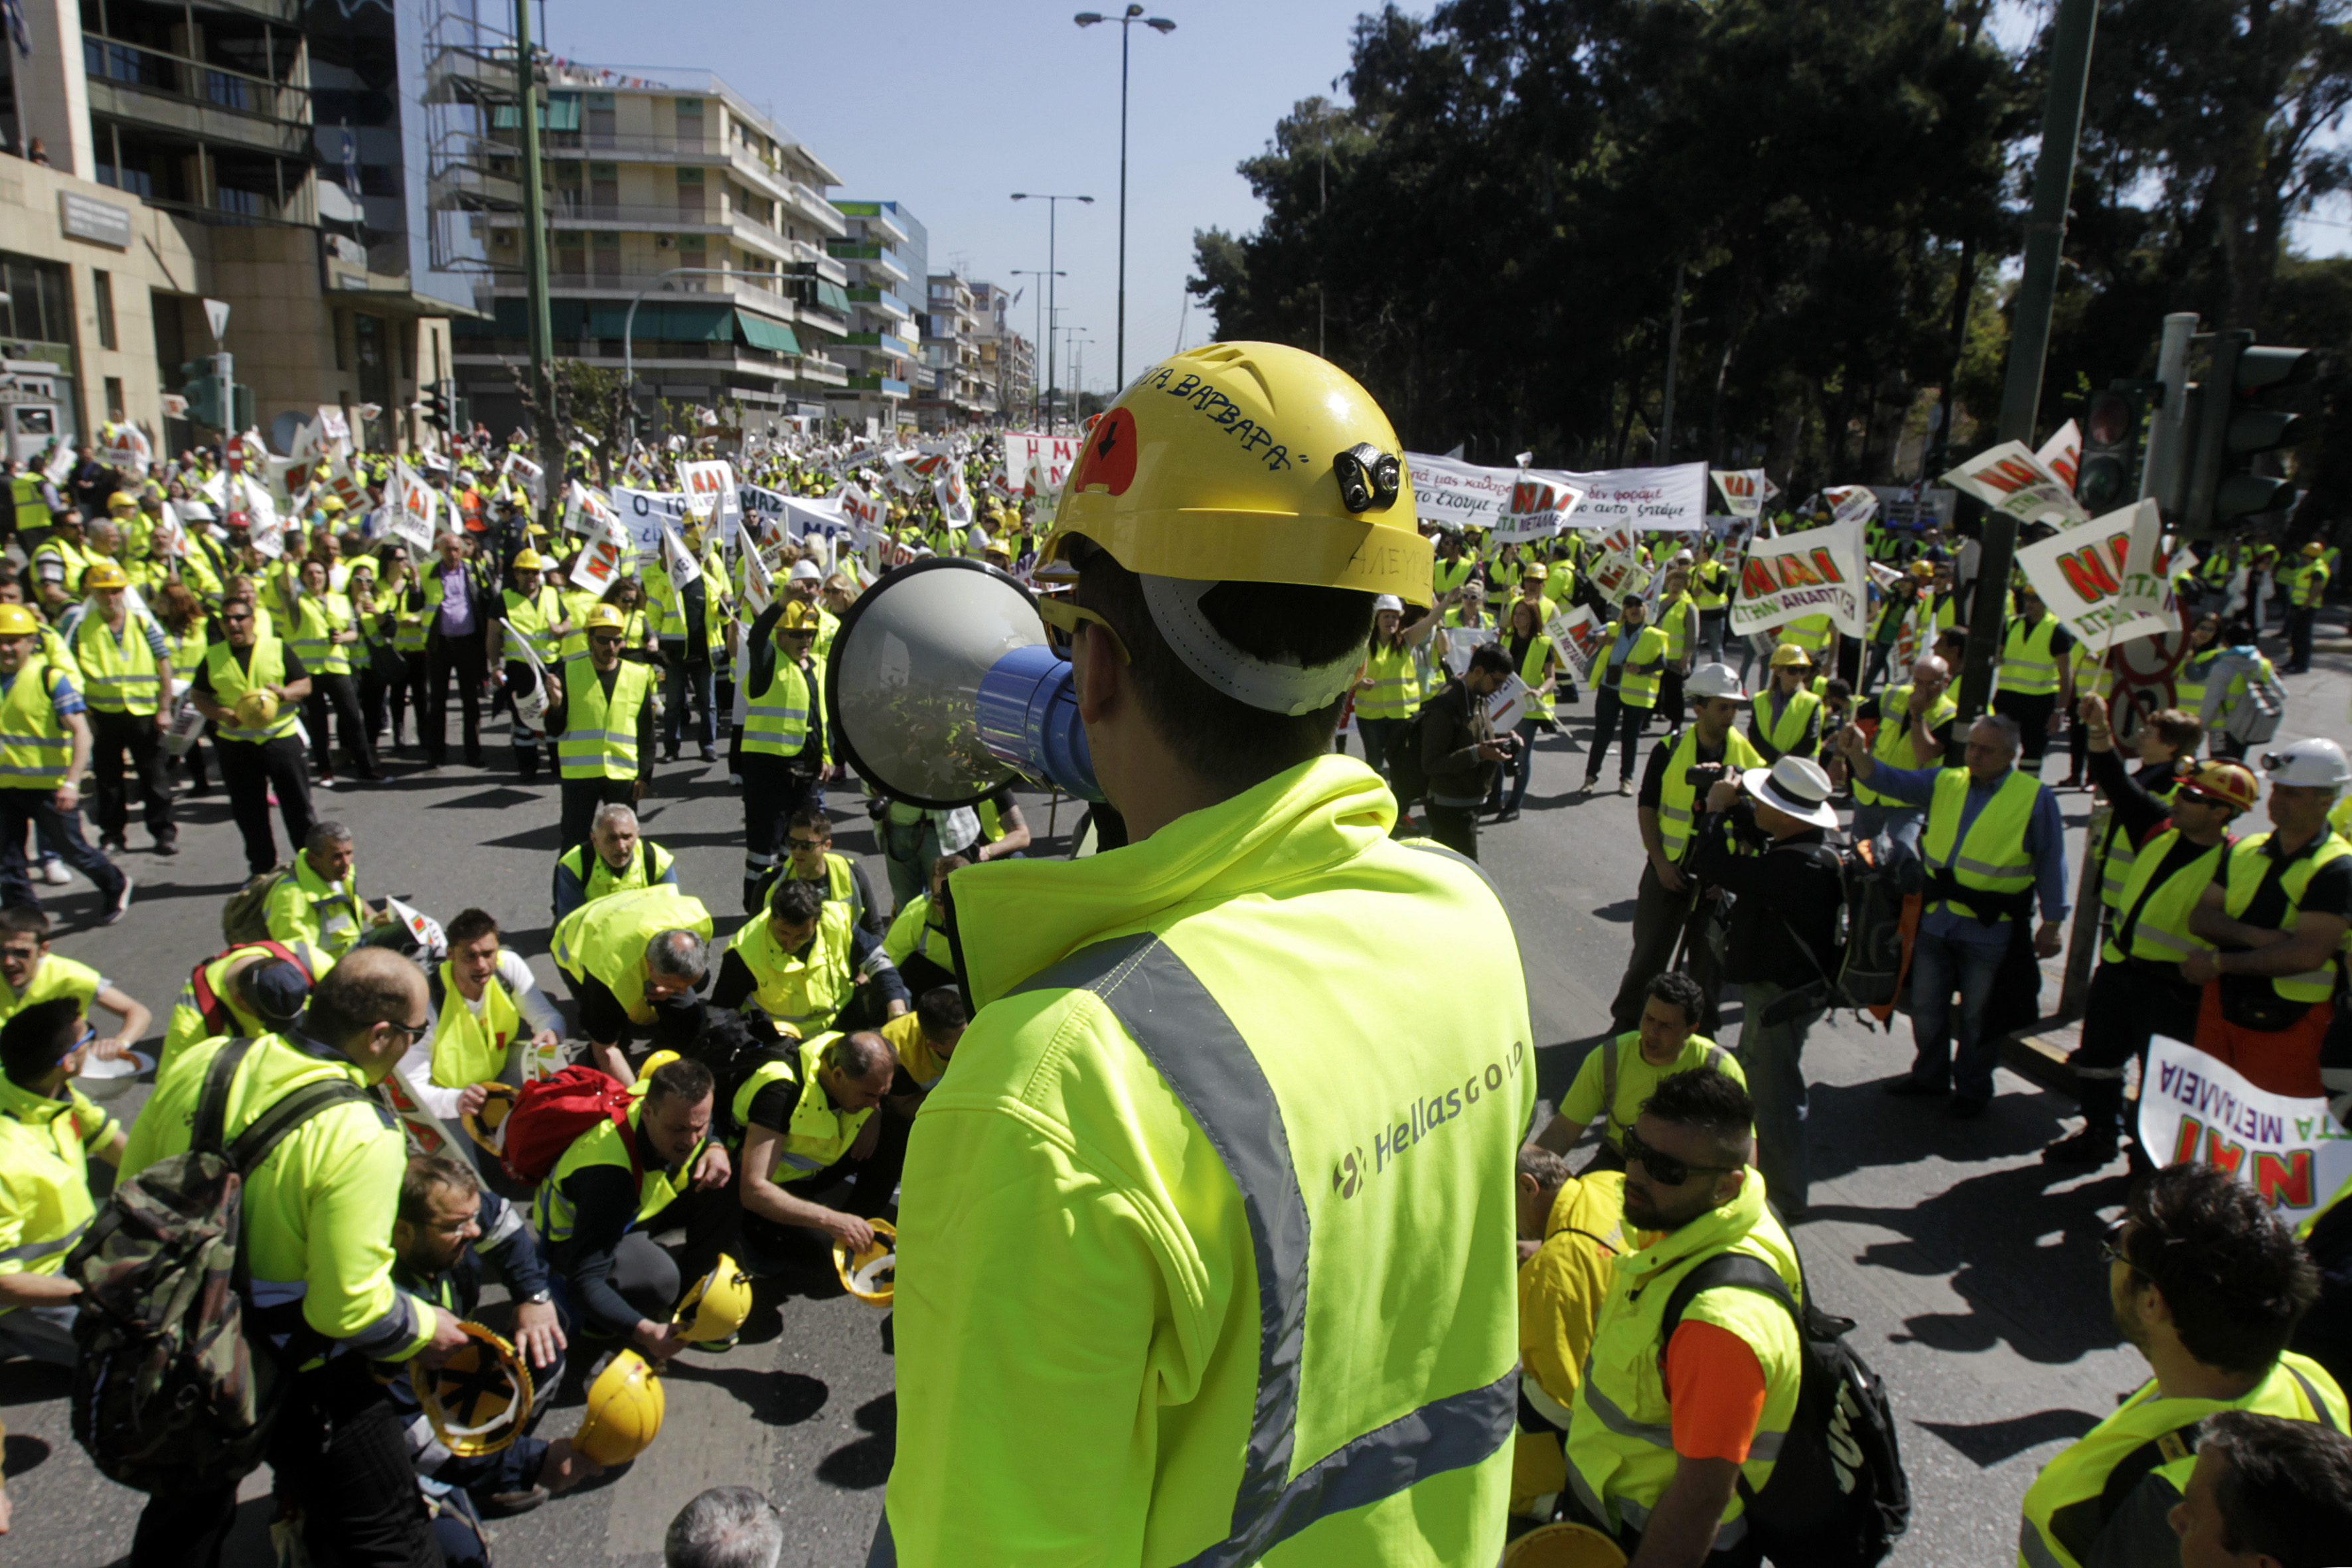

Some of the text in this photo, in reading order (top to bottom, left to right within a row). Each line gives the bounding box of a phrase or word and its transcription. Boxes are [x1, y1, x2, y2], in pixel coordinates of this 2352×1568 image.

[333, 475, 366, 510] ΝΑΙ
[690, 469, 727, 494] ΝΑΙ
[1511, 483, 1575, 514] ΝΑΙ
[1743, 546, 1845, 600] ΝΑΙ
[1733, 599, 1780, 623] ΣΤΗΝ
